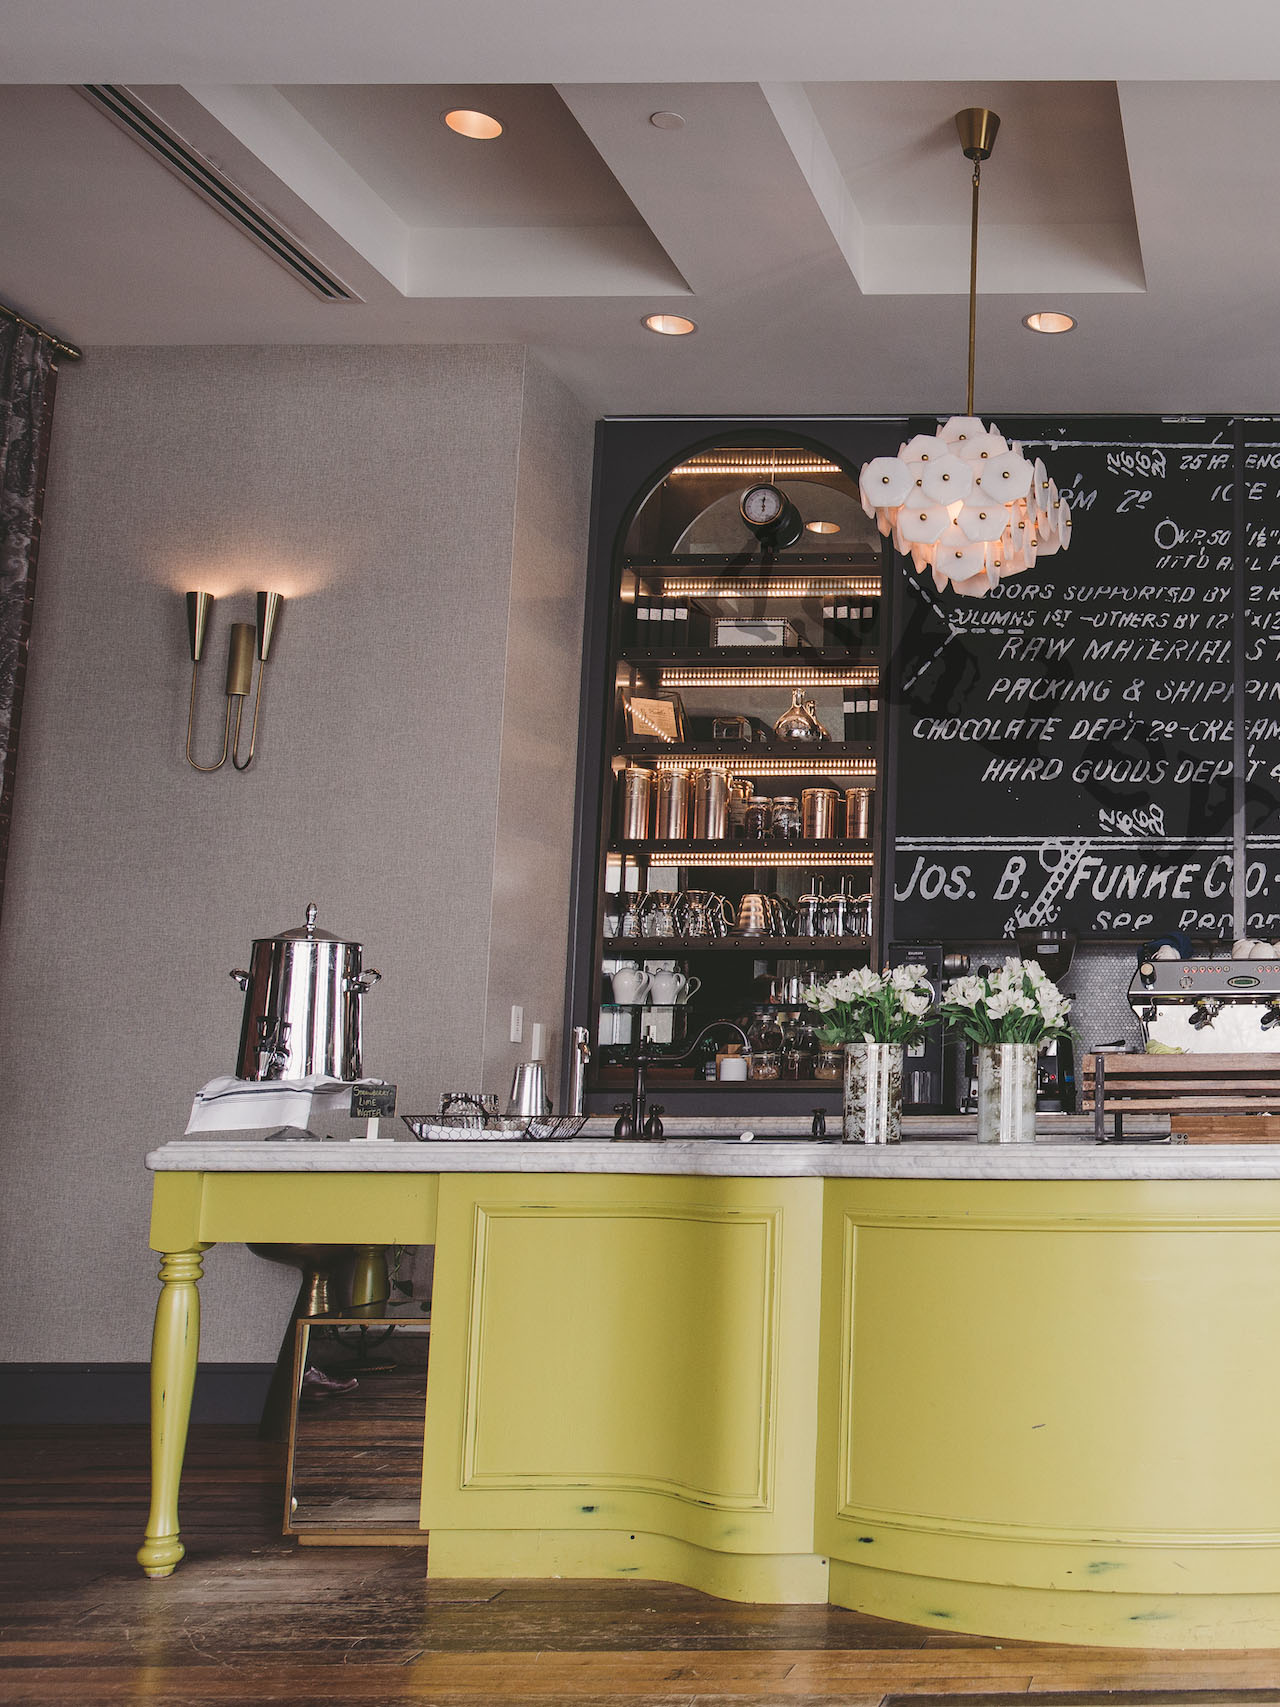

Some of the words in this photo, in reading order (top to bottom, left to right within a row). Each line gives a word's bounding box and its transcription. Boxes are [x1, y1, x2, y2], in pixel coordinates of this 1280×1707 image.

[998, 636, 1076, 664] RAW
[986, 677, 1113, 704] PACKING
[1121, 677, 1147, 704] &
[912, 716, 1064, 742] CHOCOLATE
[980, 757, 1066, 784] HARD
[893, 855, 977, 902] JOS.
[992, 855, 1031, 901] B.
[1064, 855, 1201, 901] FUNKE
